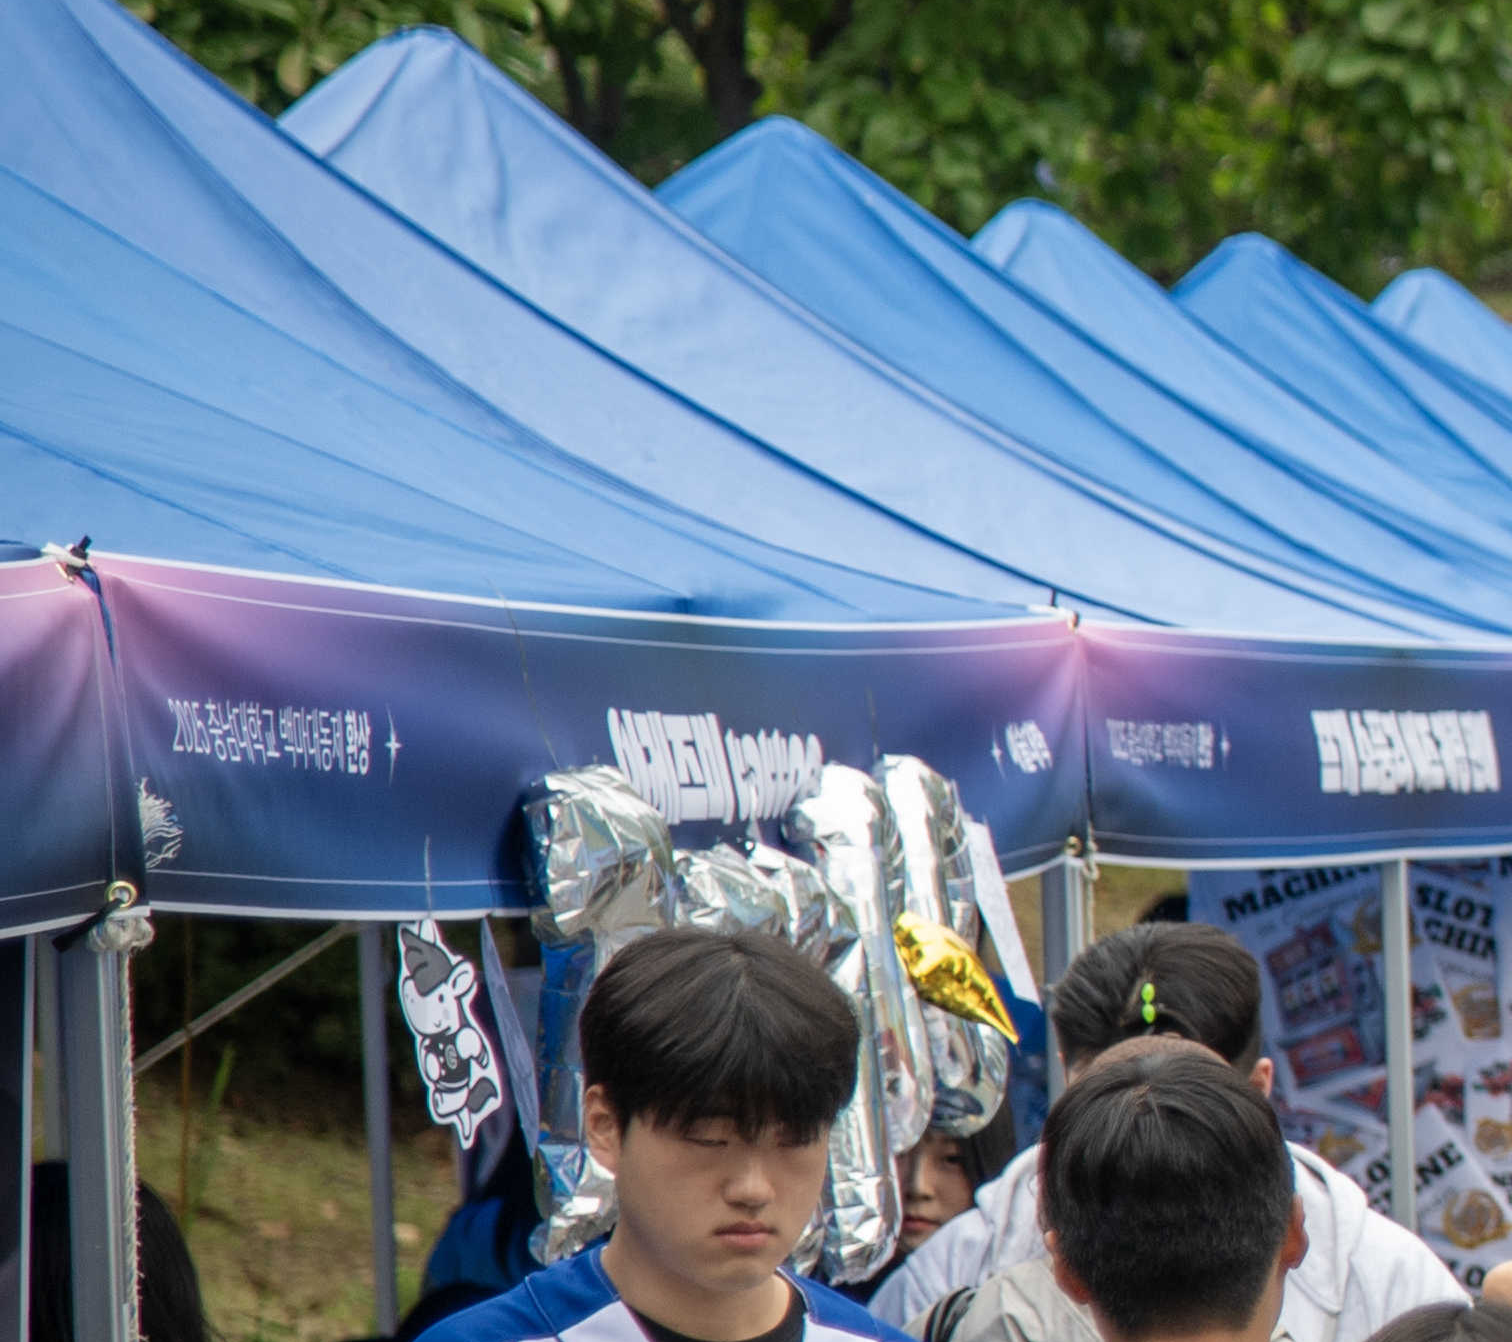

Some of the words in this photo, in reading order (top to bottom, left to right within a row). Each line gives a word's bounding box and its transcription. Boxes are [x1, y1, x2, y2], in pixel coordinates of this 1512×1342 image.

[168, 698, 211, 755] 2025
[205, 698, 281, 766] 충남대학교
[279, 704, 345, 773] 백마대동제
